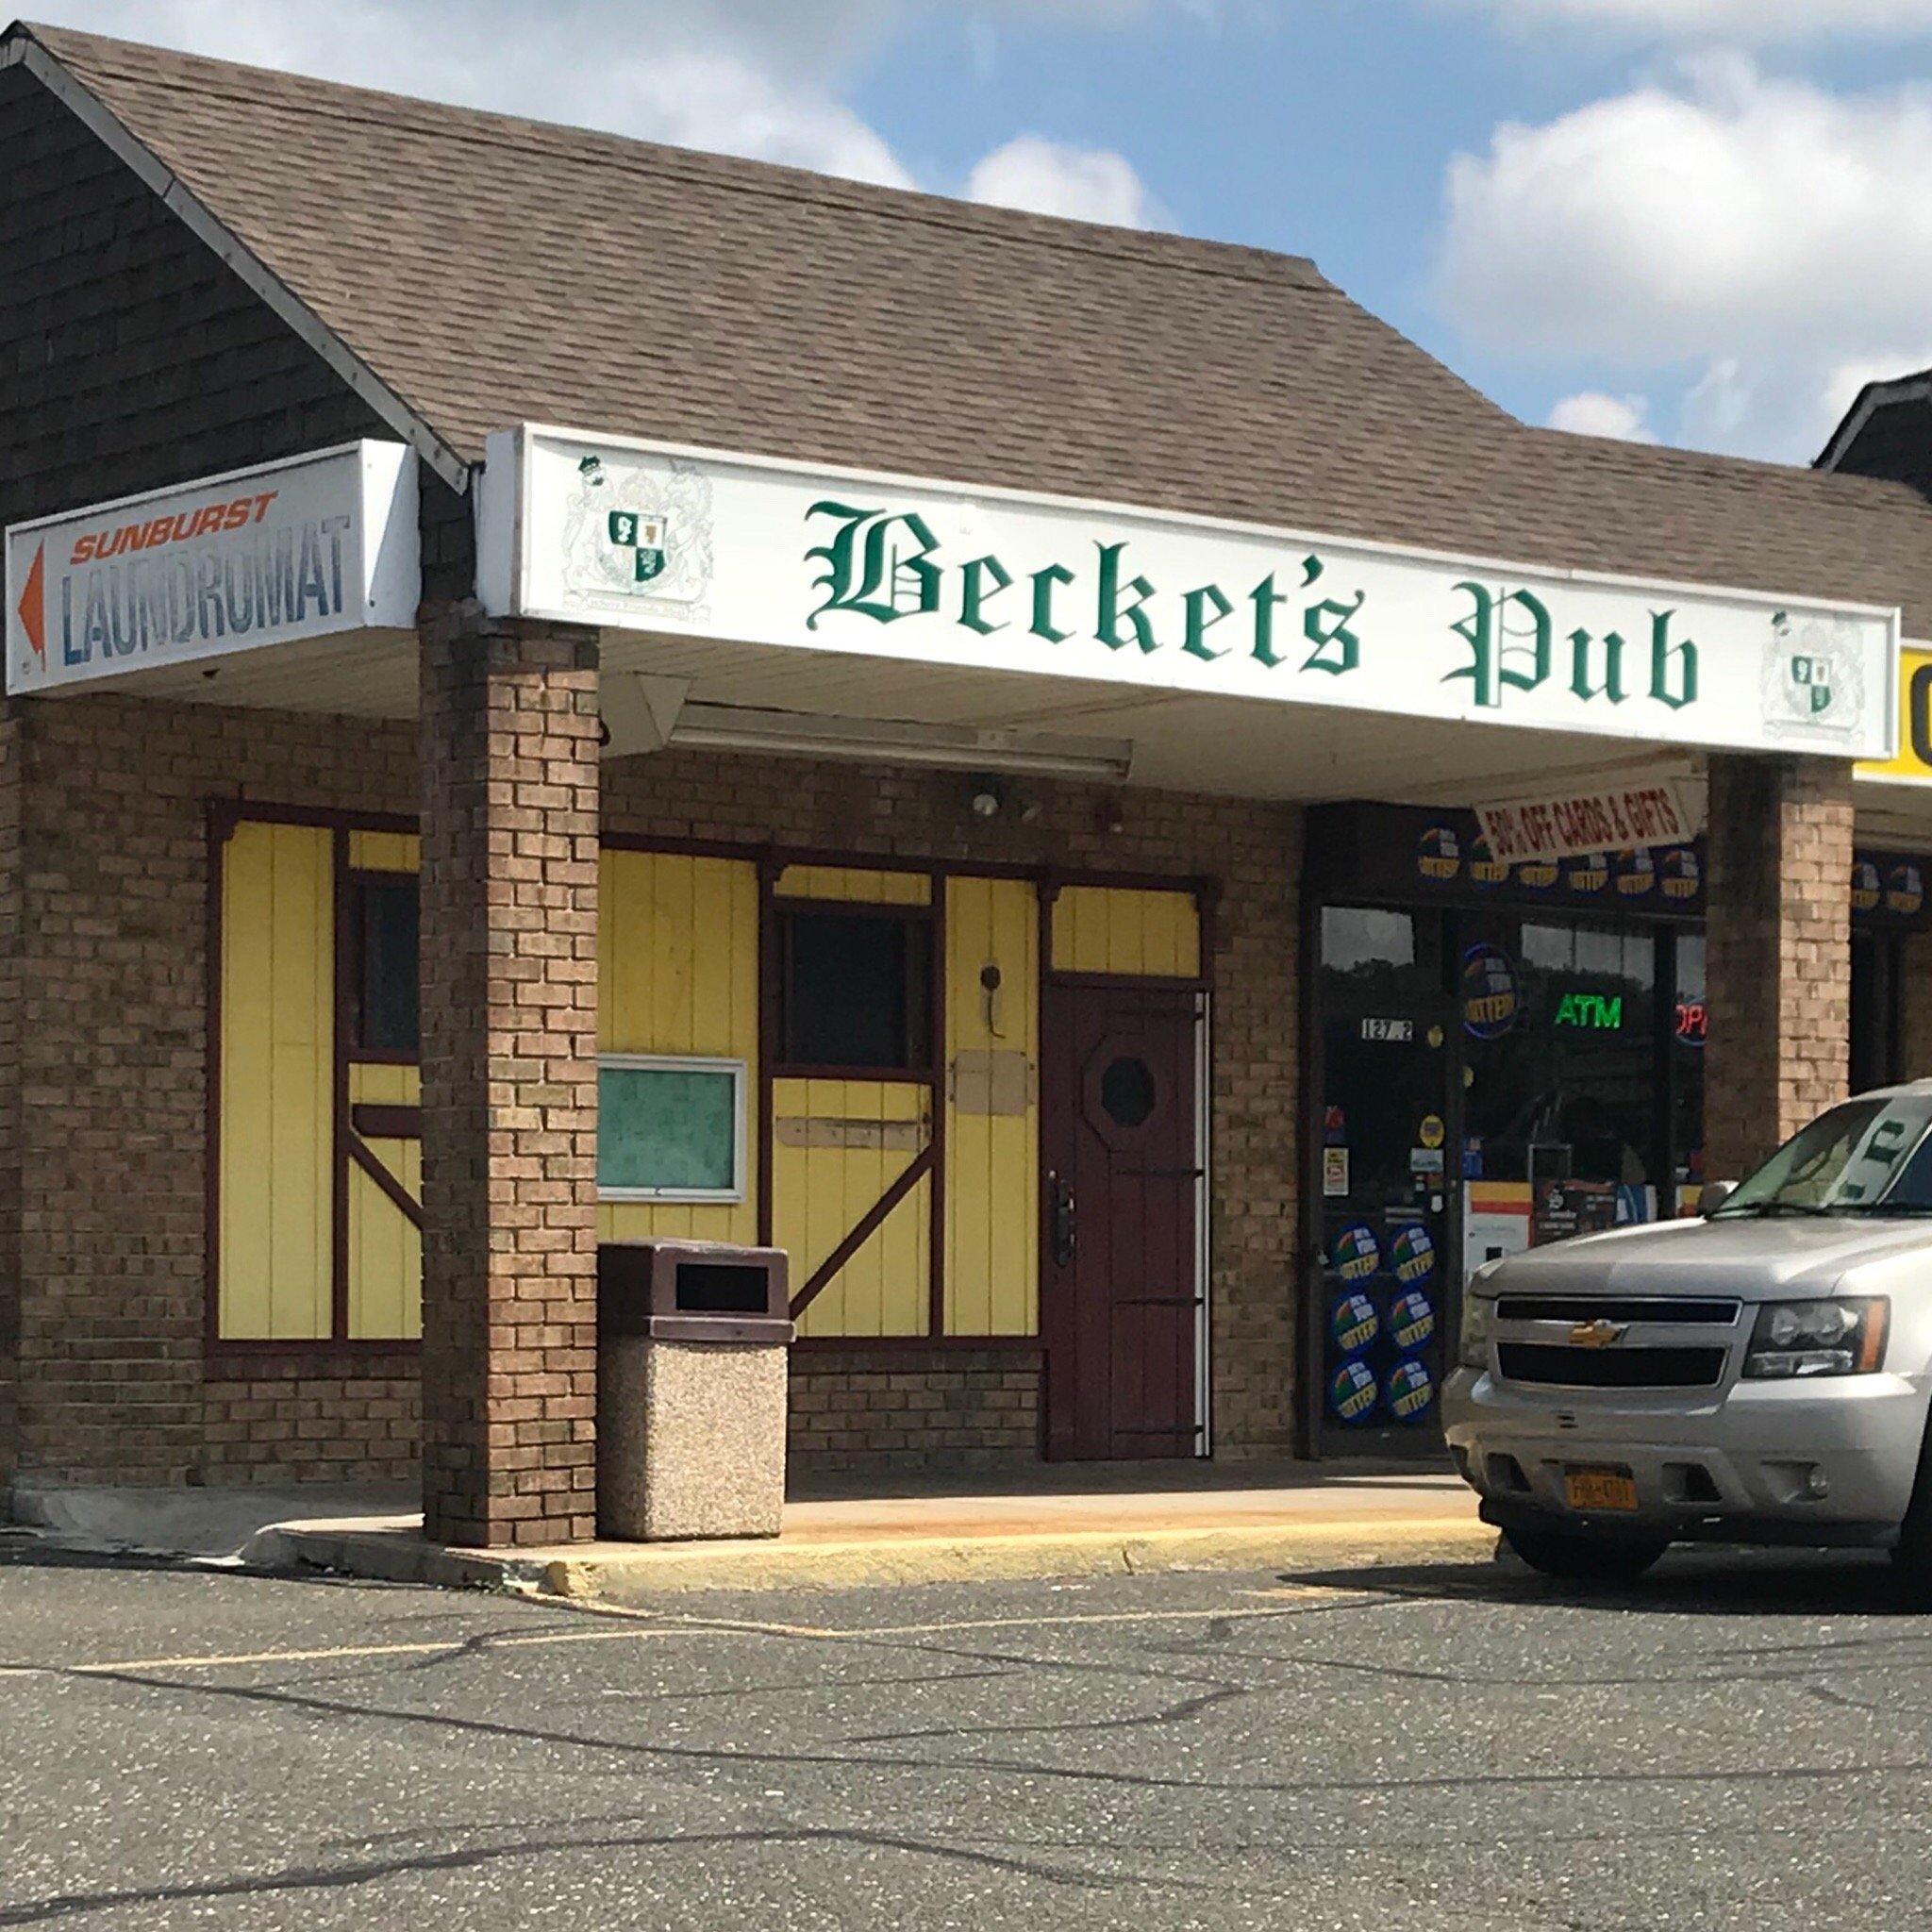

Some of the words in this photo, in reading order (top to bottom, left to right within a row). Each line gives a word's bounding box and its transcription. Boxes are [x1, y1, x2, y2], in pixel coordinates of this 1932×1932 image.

[70, 490, 279, 565] SUNBURST
[62, 514, 351, 666] LAUNDROMAT
[804, 500, 1365, 676] Becket's
[1440, 581, 1698, 710] Pub
[1520, 804, 1557, 852] OFF
[1553, 796, 1613, 847] CARDS
[1624, 787, 1680, 839] GIFTS
[1556, 992, 1622, 1028] ATM
